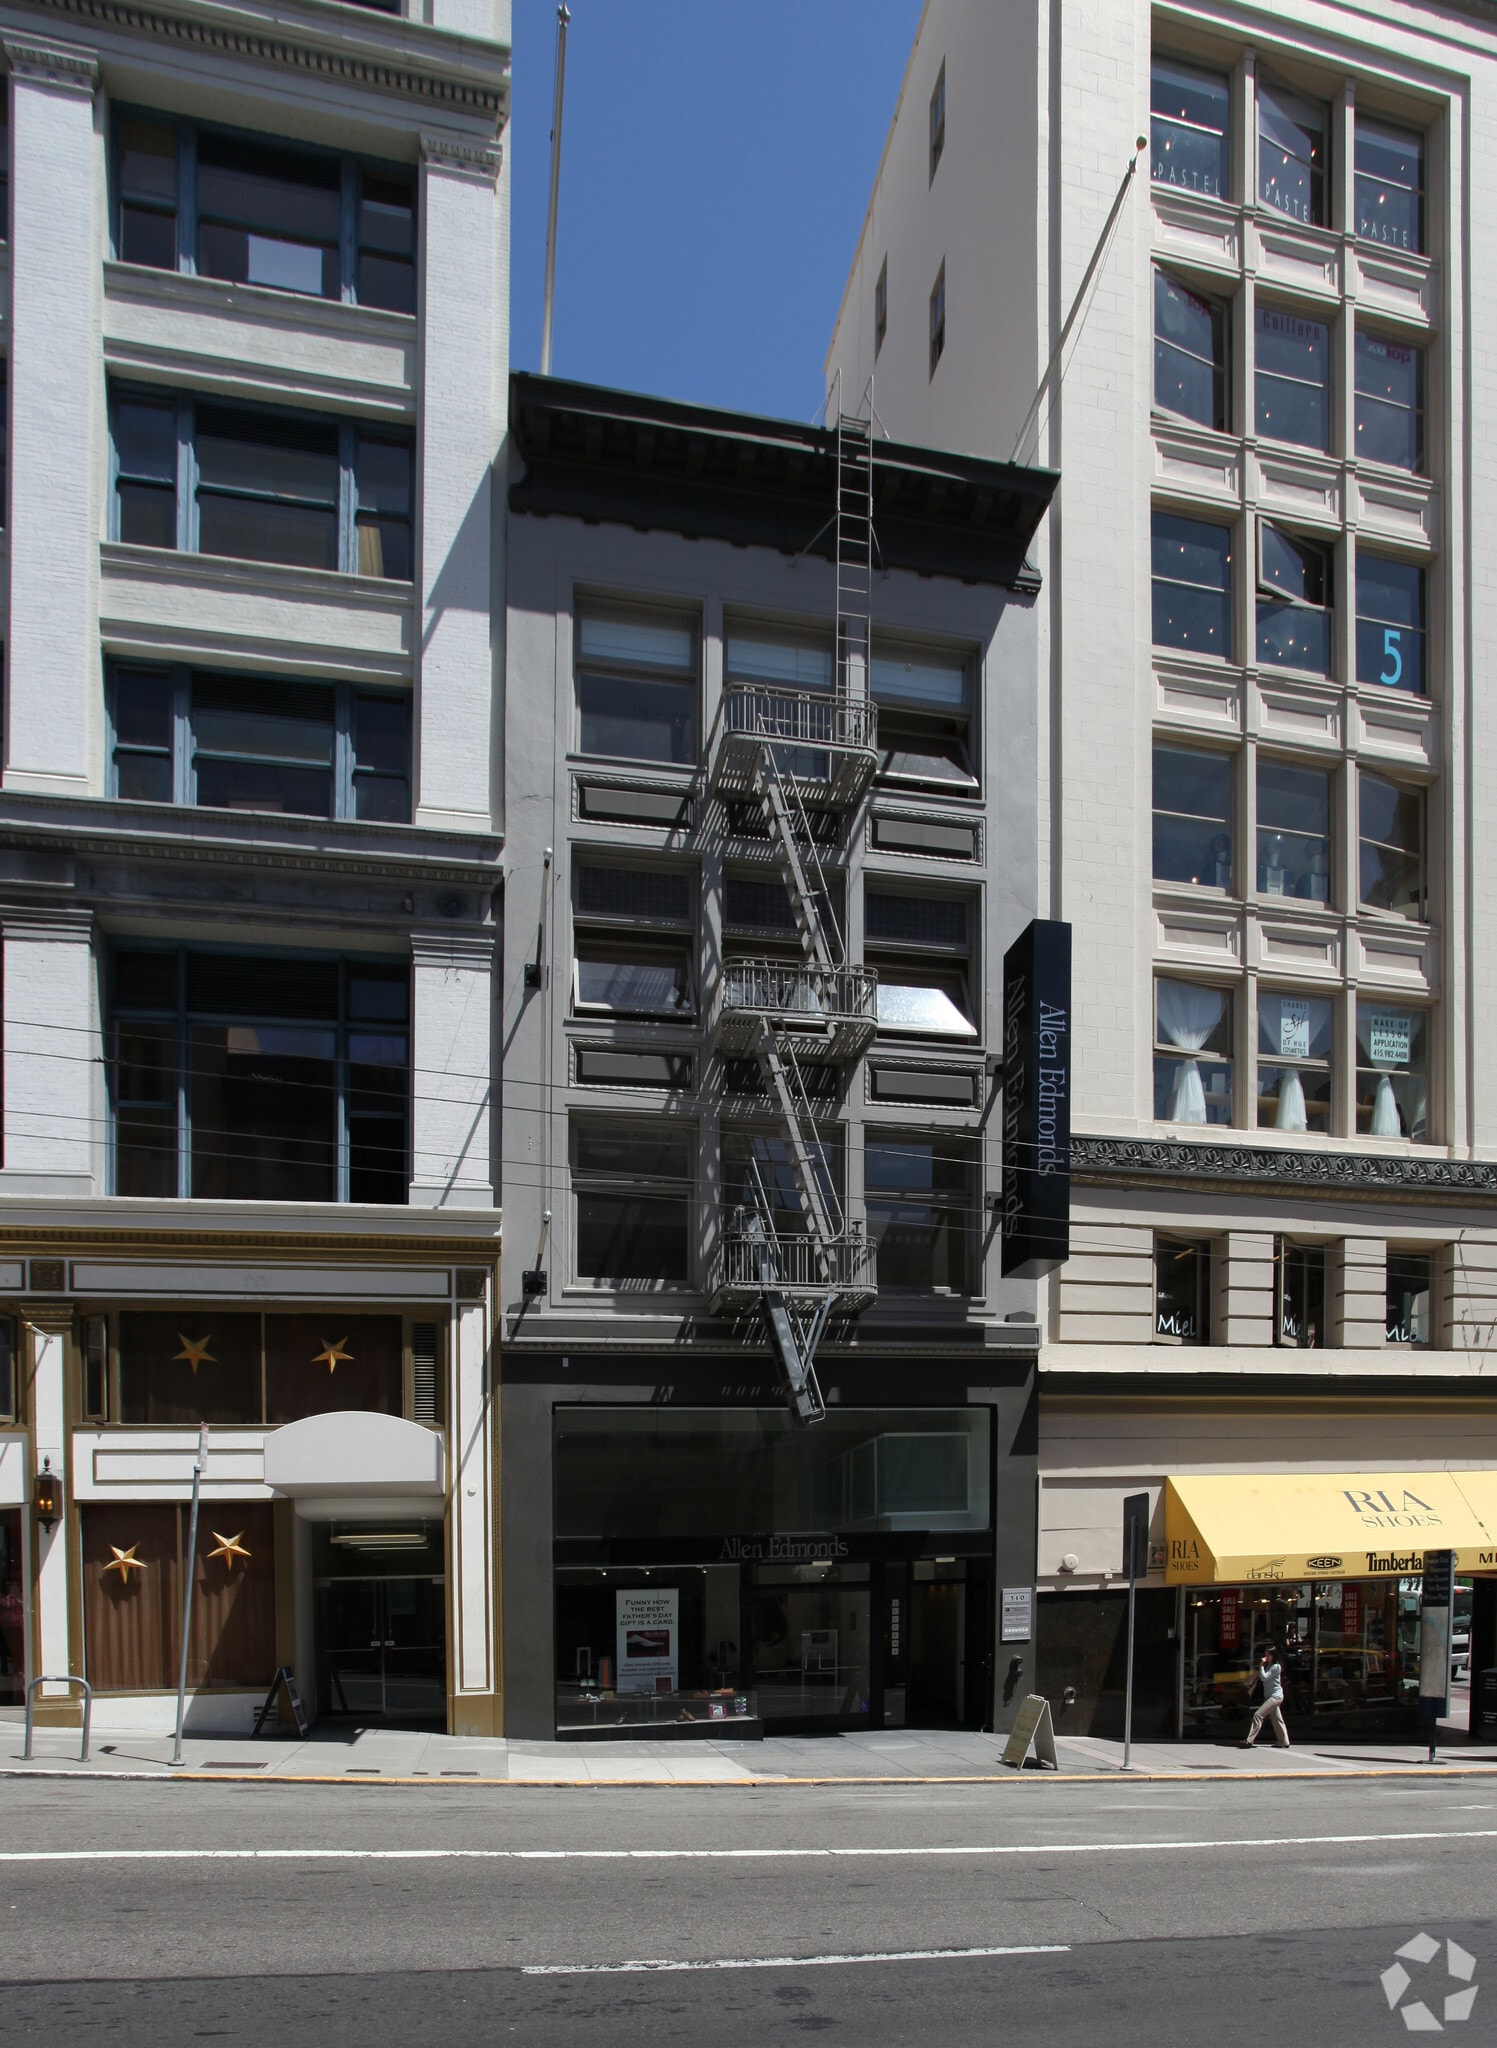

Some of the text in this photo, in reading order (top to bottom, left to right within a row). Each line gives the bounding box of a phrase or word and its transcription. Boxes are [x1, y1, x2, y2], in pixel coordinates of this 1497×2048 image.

[1158, 162, 1220, 196] PASTEL
[1380, 628, 1402, 685] 5
[1282, 1001, 1307, 1010] SHADES
[1007, 976, 1026, 1063] Allen
[1373, 1018, 1408, 1029] MAKE-UP
[1039, 1000, 1066, 1059] Allen
[1373, 1029, 1408, 1039] LESSON
[1373, 1039, 1408, 1049] APPLICATION
[1038, 1066, 1066, 1177] Edmonds
[1005, 1062, 1025, 1239] Edmonds
[1339, 1489, 1435, 1512] RIA
[1361, 1514, 1443, 1528] SHOES
[720, 1536, 849, 1559] Allen Edmonds
[1172, 1540, 1200, 1559] RIA
[1172, 1561, 1199, 1571] SHOES
[1307, 1557, 1342, 1569] KEEN
[1366, 1552, 1424, 1572] Timberla
[1222, 1606, 1236, 1614] SALE
